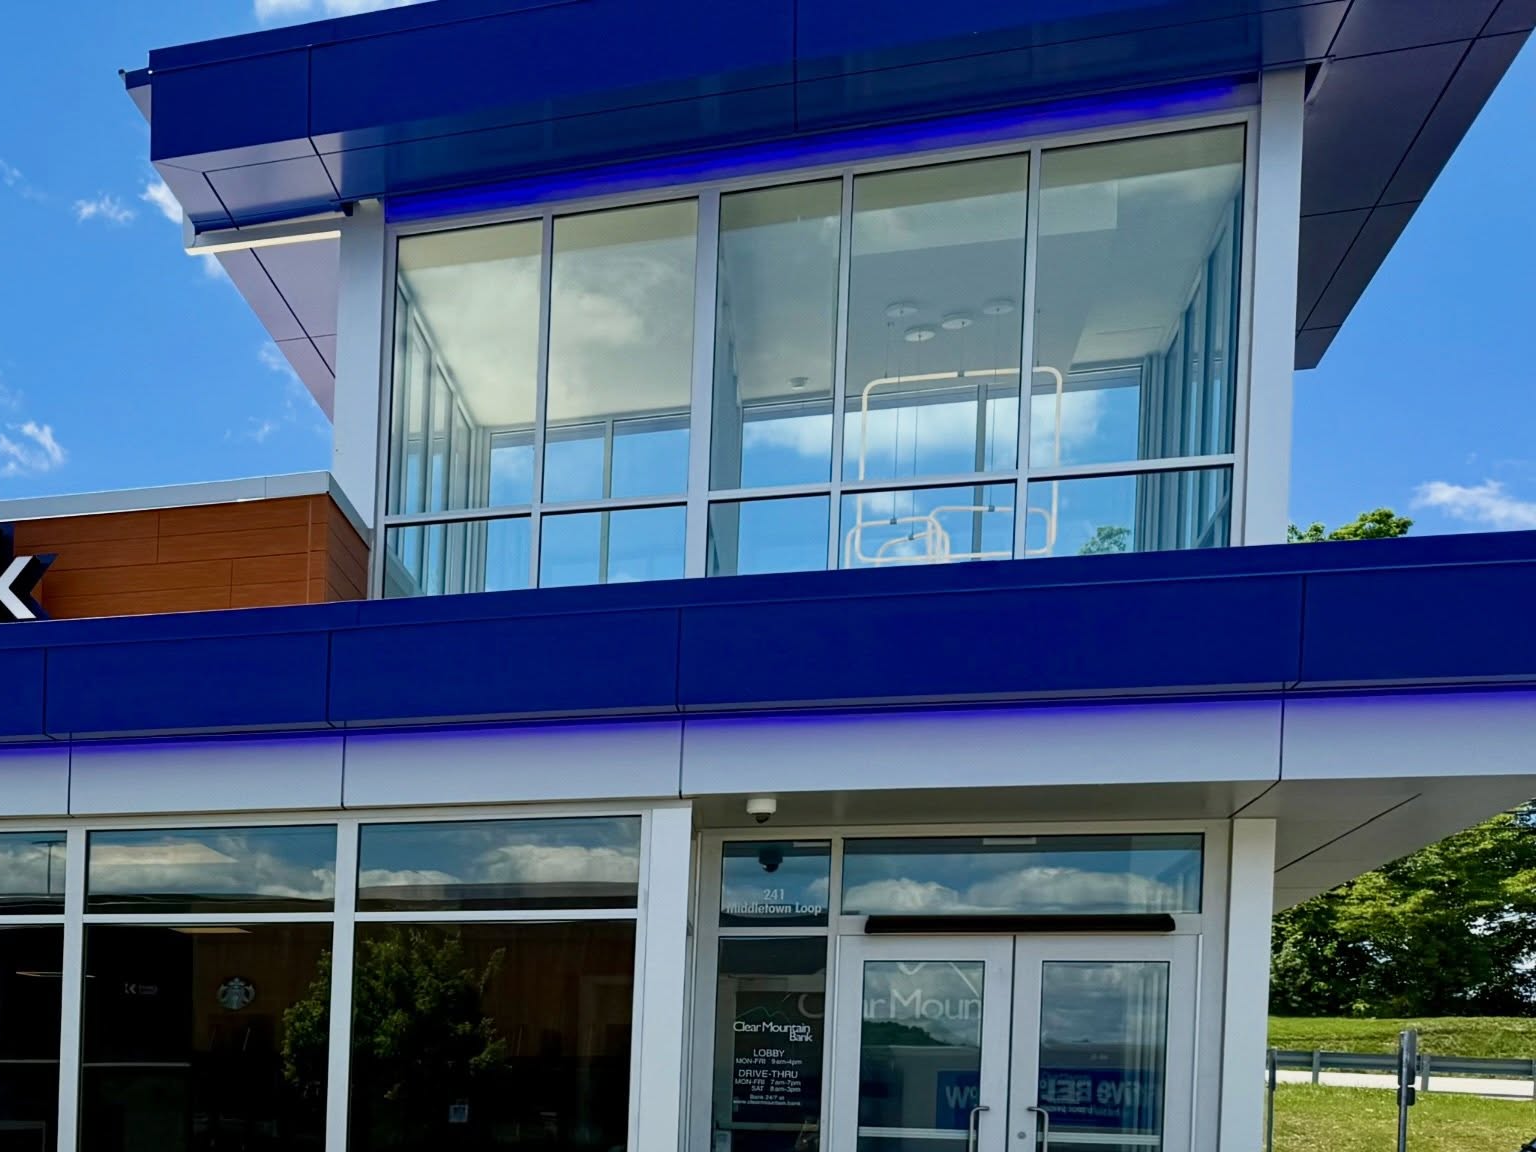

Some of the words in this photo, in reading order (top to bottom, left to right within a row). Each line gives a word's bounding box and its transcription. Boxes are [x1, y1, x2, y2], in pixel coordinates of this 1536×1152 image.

[763, 888, 785, 901] 241
[726, 903, 792, 914] Middletown
[795, 902, 822, 916] Loop
[889, 988, 981, 1020] Moun
[733, 1021, 761, 1032] Clear
[762, 1021, 811, 1033] Mountain
[789, 1030, 813, 1042] Bank
[753, 1048, 785, 1057] LOBBY
[735, 1057, 766, 1065] MON-FRI
[738, 1069, 798, 1079] DRIVE-THRU
